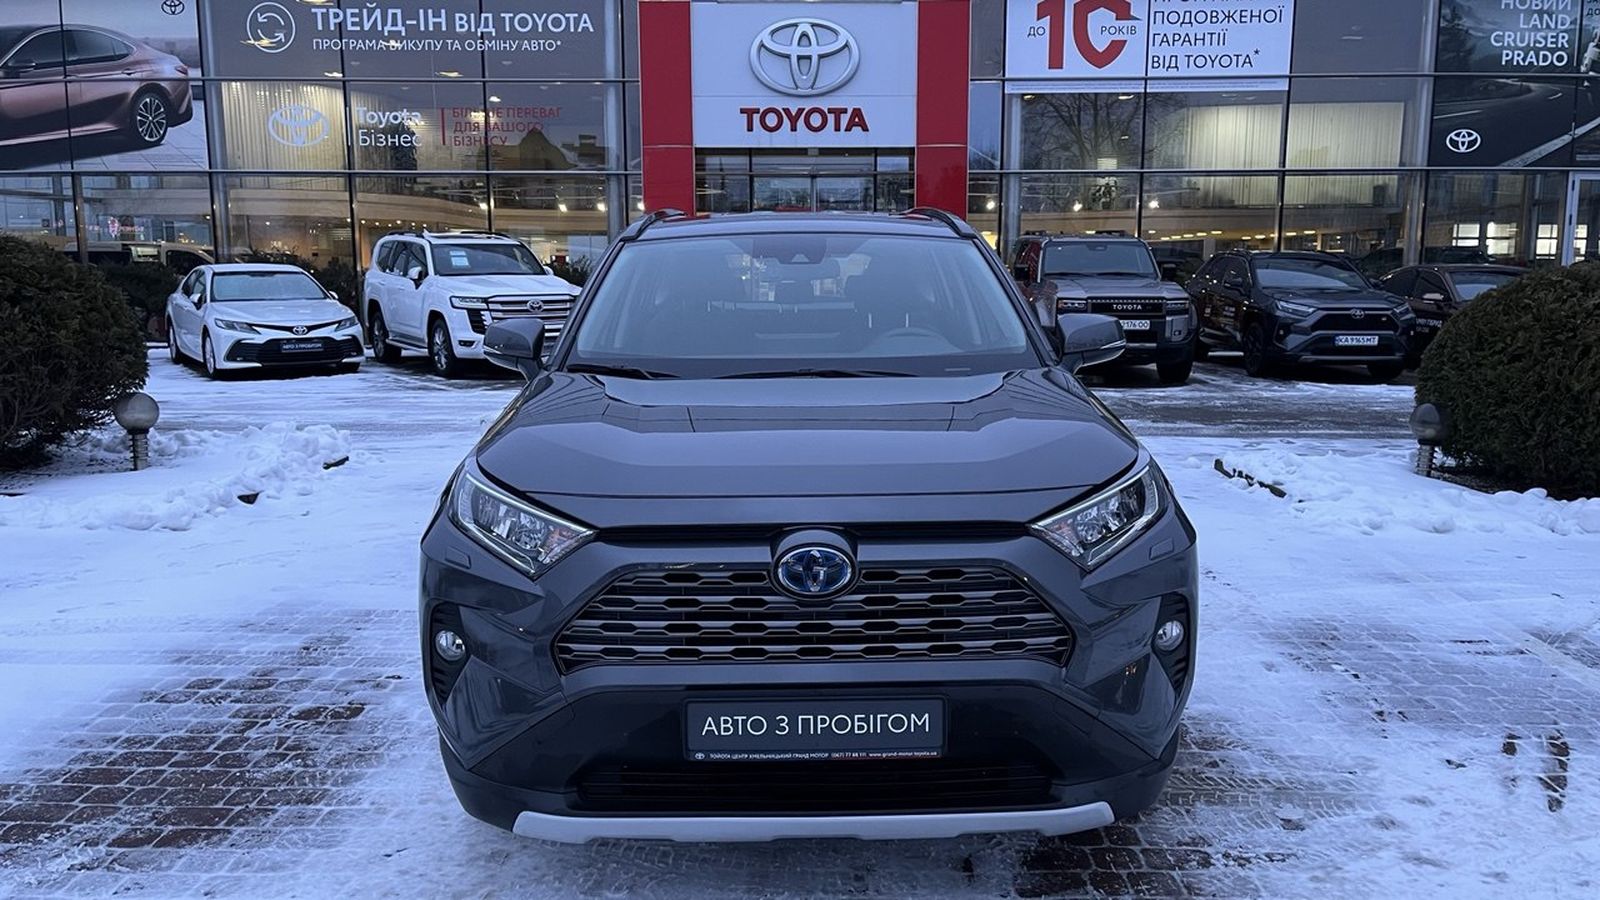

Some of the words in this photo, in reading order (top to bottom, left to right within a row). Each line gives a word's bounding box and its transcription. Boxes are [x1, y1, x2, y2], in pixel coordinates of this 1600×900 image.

[311, 3, 447, 36] ТРЕЙД-ІН
[455, 13, 496, 36] ВІД
[500, 13, 594, 32] TOYOTA
[1153, 5, 1285, 27] ПОДОВЖЕНОЇ
[1520, 13, 1571, 29] LAND
[1027, 26, 1046, 38] ДО
[1100, 25, 1137, 36] РОКІВ
[1152, 28, 1228, 47] ГАРАНТІЇ
[1490, 30, 1569, 48] CRUISER
[313, 39, 387, 50] ПРОГРАМА
[389, 39, 443, 50] ВИКУПУ
[446, 40, 461, 51] ТА
[465, 40, 519, 51] ОБМІНУ
[1151, 55, 1179, 72] ВІД
[1501, 50, 1568, 67] PRADO
[356, 107, 422, 128] Toyota
[452, 107, 503, 118] БІЛШЕ
[506, 107, 561, 118] ПЕРЕВАГ
[739, 106, 870, 133] TOYOTA
[453, 121, 480, 133] ДЛЯ
[358, 129, 422, 147] Бізнес
[453, 135, 508, 147] БІЗНСУ
[702, 716, 768, 736] АВТО
[775, 715, 790, 735] З
[798, 713, 930, 734] ПРОБІГОМ
